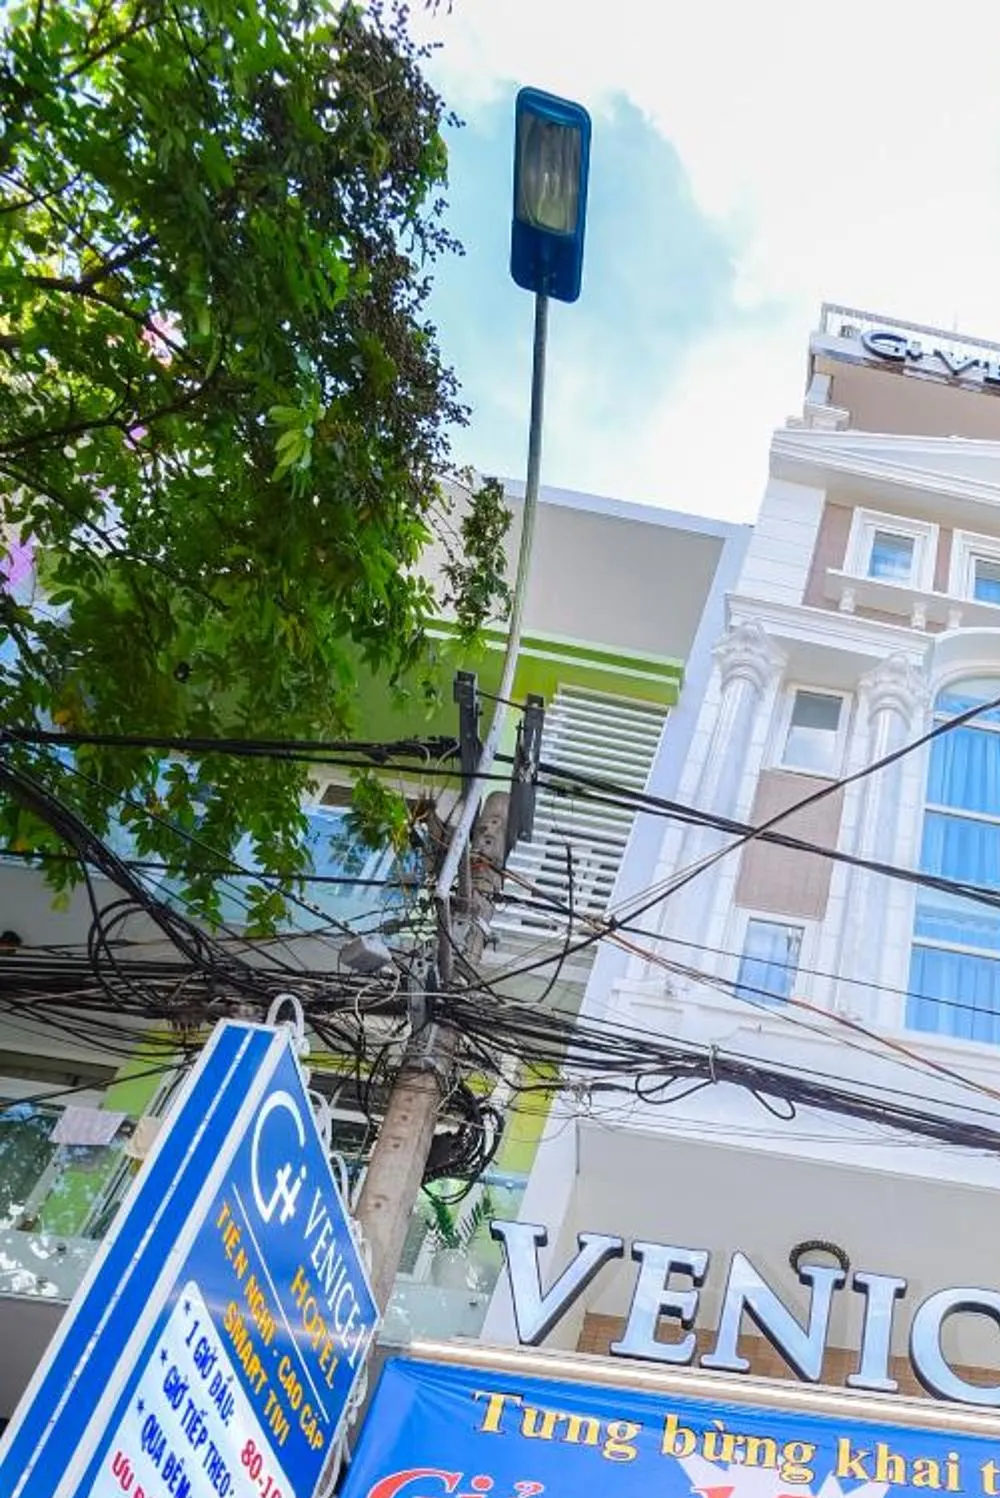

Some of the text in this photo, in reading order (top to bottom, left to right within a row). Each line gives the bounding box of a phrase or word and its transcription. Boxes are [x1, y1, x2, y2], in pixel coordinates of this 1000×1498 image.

[290, 1264, 339, 1389] HOTEL
[223, 1301, 290, 1448] SMART TIVI
[278, 1356, 302, 1411] CAO
[141, 1413, 167, 1468] QUA
[659, 1413, 818, 1484] bừng
[834, 1437, 966, 1493] khai
